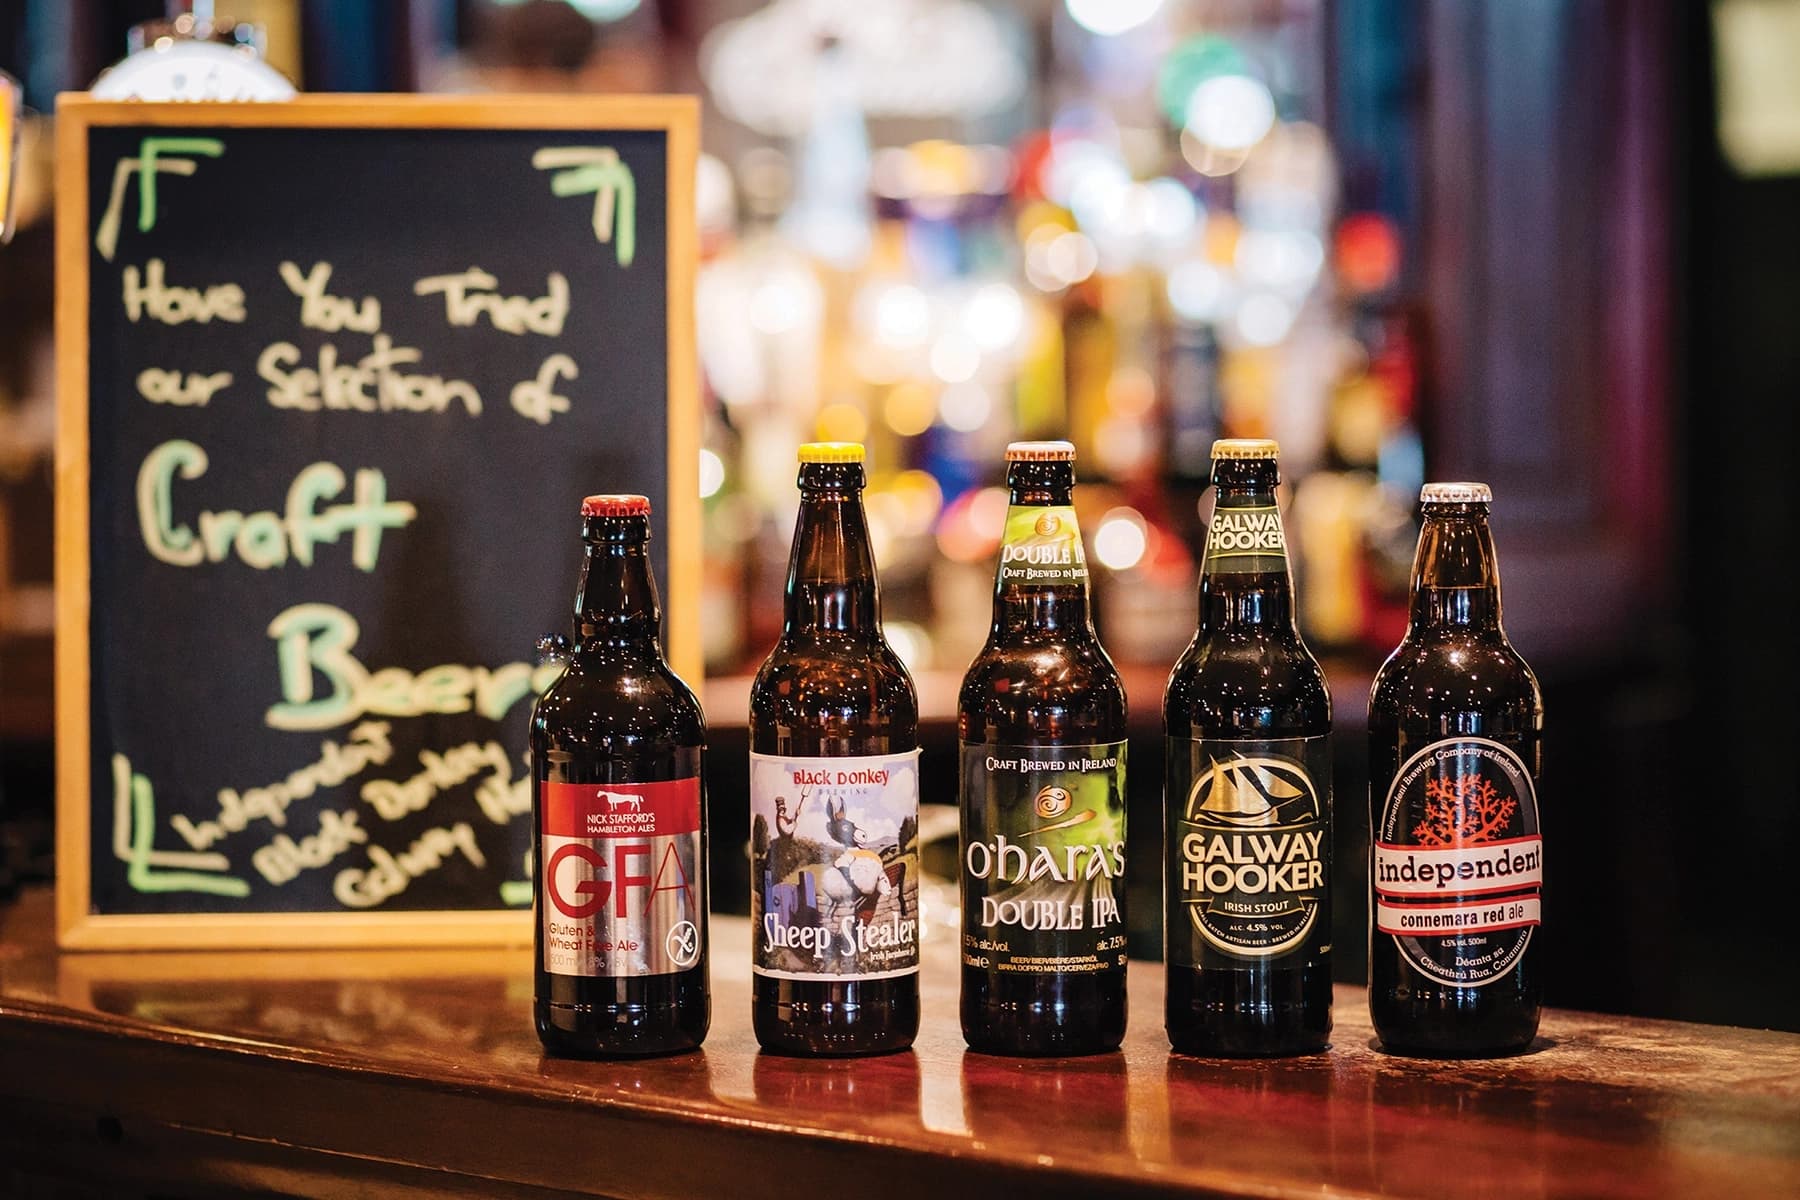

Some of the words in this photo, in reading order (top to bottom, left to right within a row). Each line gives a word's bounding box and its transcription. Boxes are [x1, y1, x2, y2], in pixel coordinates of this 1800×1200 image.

[122, 257, 246, 324] Have
[279, 261, 381, 333] You
[414, 266, 570, 336] Tried
[136, 367, 234, 406] our
[257, 333, 483, 418] Selection
[510, 354, 578, 424] of
[136, 440, 417, 573] Craft
[1002, 544, 1071, 565] DOUBLE
[1435, 747, 1483, 760] Company
[587, 814, 607, 825] NICK
[609, 812, 655, 824] STAFFORD'S
[587, 824, 636, 834] HAMBLETON
[637, 823, 655, 833] ALES
[1183, 830, 1323, 864] GALWAY
[547, 842, 696, 919] GFA
[1183, 860, 1324, 894] HOOKER
[1379, 845, 1540, 889] independent
[982, 897, 1083, 930] DOUBLE
[1091, 898, 1121, 929] IPA
[1224, 901, 1252, 913] IRISH
[1254, 900, 1289, 913] STOUT
[1401, 910, 1477, 928] connemara
[1484, 906, 1504, 923] red
[1508, 903, 1524, 920] ale
[549, 923, 583, 937] Gluten
[764, 912, 830, 958] Sheep
[841, 912, 915, 957] Stealer
[1246, 923, 1268, 932] 4.5%
[550, 937, 582, 952] Wheat
[617, 940, 639, 952] Ale
[1455, 955, 1492, 966] Déanta
[1493, 946, 1505, 958] sa
[1492, 930, 1528, 971] Conamara
